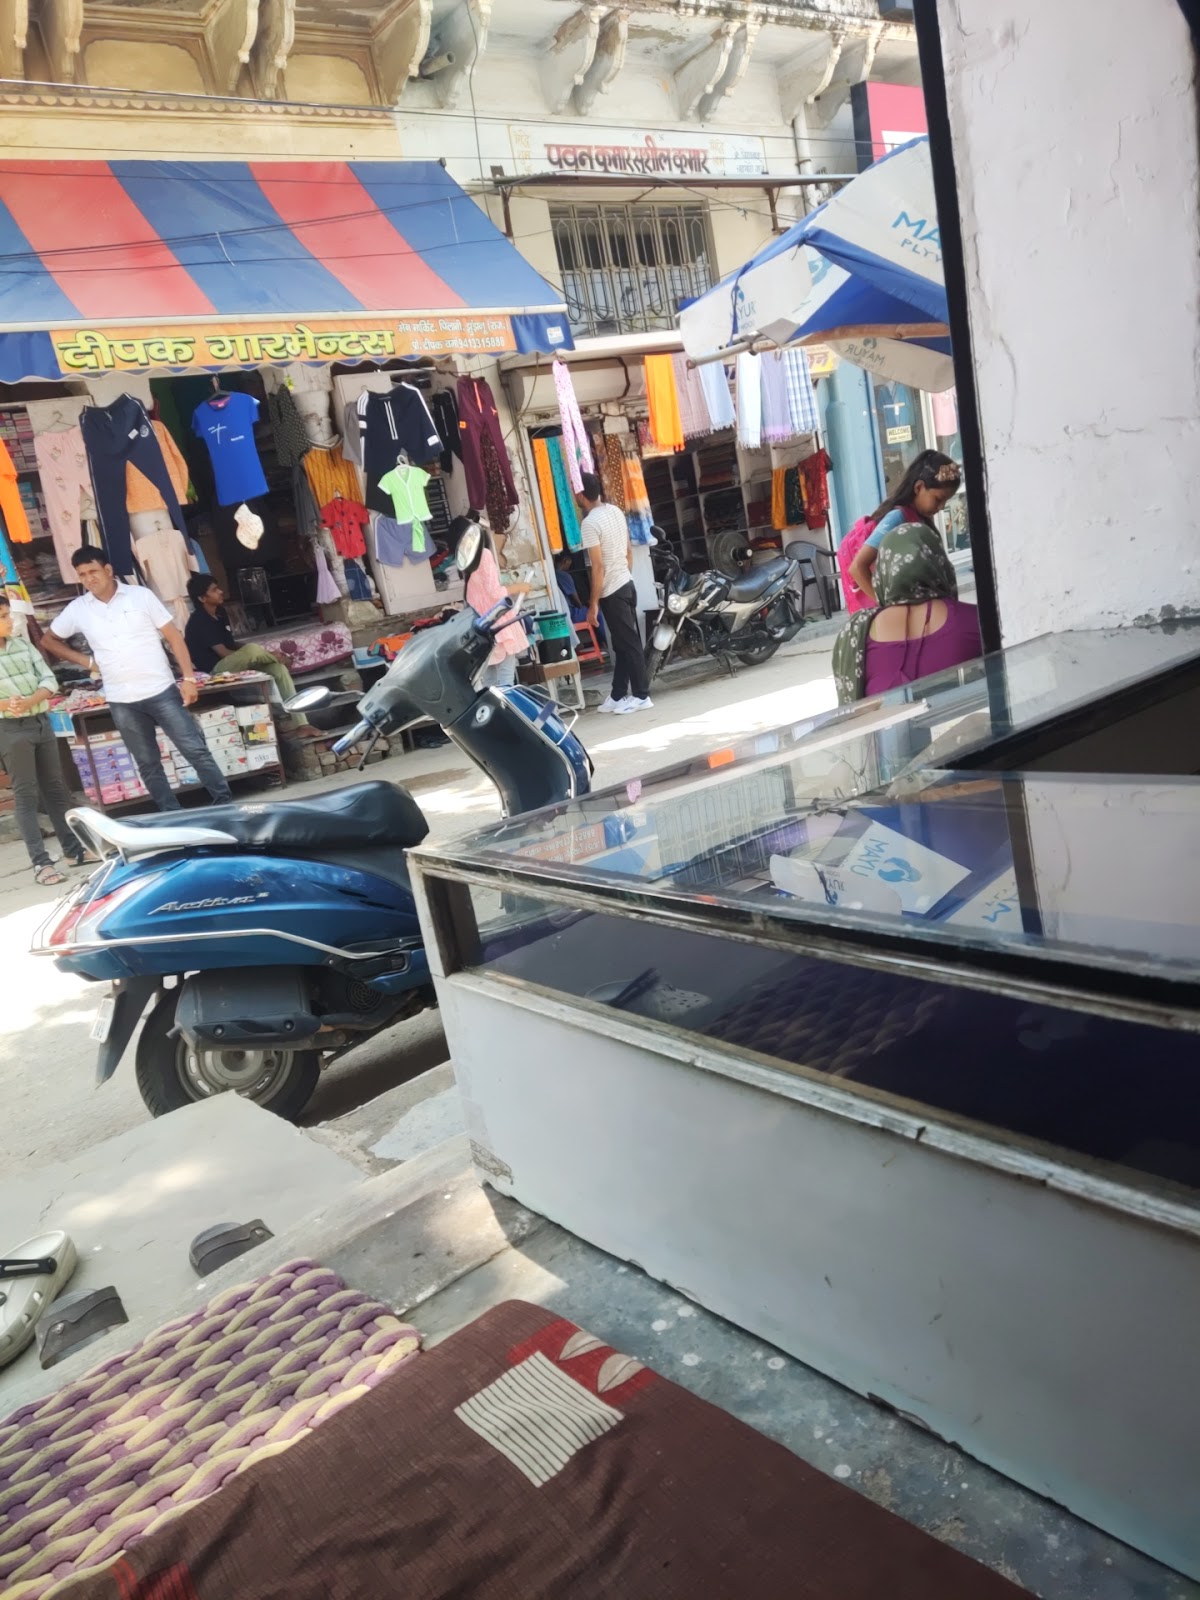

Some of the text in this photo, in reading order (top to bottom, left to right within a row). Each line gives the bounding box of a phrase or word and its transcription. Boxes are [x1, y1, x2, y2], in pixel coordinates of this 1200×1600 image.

[544, 144, 594, 170] पवन
[594, 145, 634, 173] कुमार
[671, 147, 711, 174] कुमार
[57, 323, 396, 371] दीपक गारमेन्टस
[888, 427, 910, 436] WELCOME
[147, 895, 256, 915] Activa
